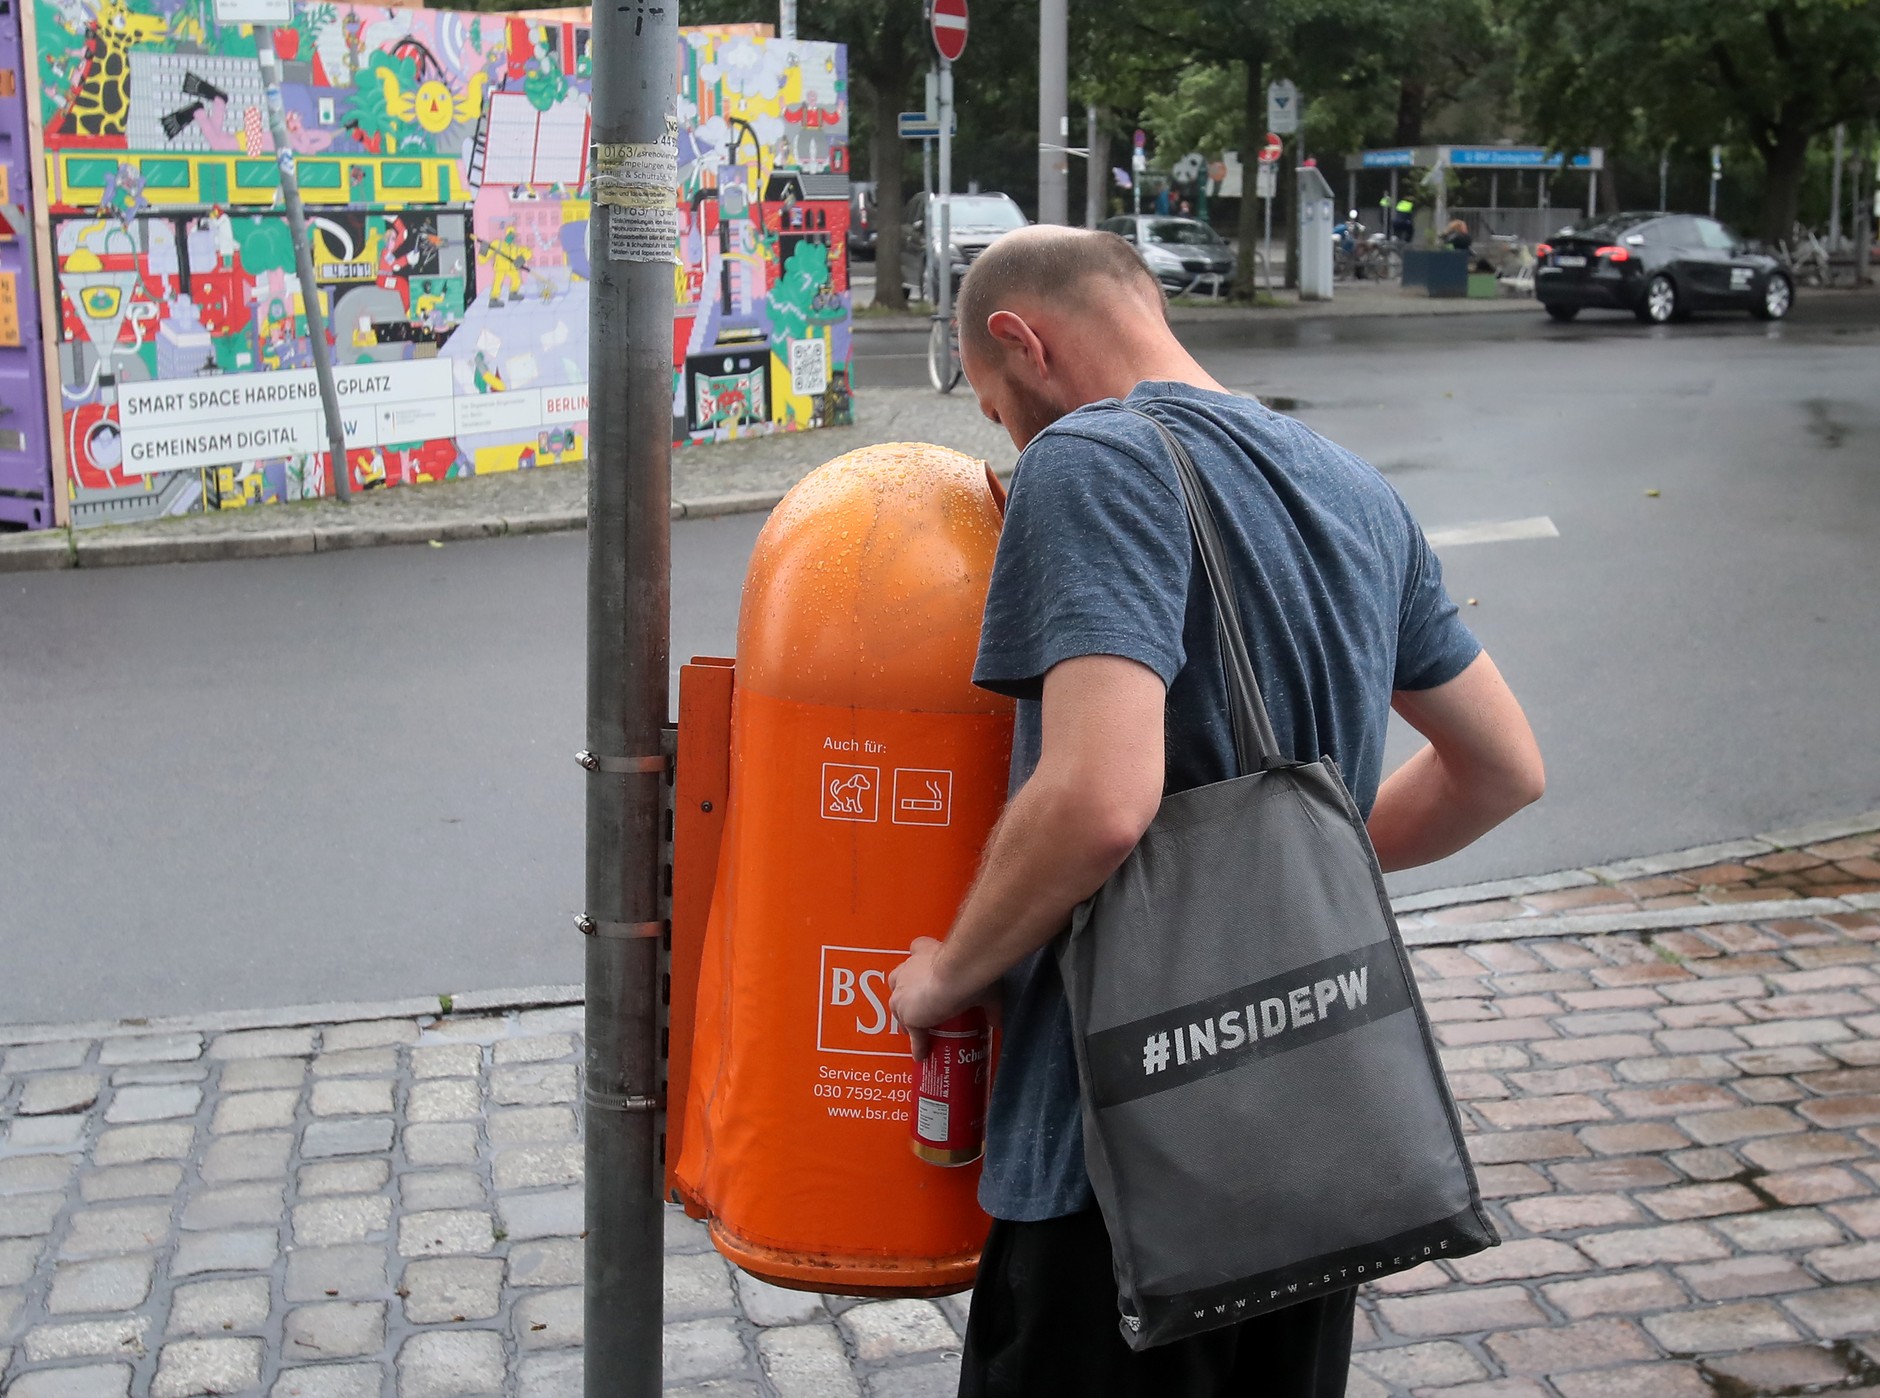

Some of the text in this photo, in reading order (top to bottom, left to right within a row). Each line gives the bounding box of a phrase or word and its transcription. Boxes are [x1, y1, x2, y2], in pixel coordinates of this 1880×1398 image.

[128, 376, 391, 415] SMART SPACE HARDENBGPLATZ
[131, 427, 298, 460] GEMEINSAM DIGITAL
[823, 736, 887, 754] Auch für:
[830, 967, 899, 1036] BS
[1143, 966, 1369, 1075] #INSIDEPW
[819, 1066, 912, 1084] Service Cente
[814, 1083, 842, 1099] 030
[827, 1106, 909, 1122] www.bsr.de
